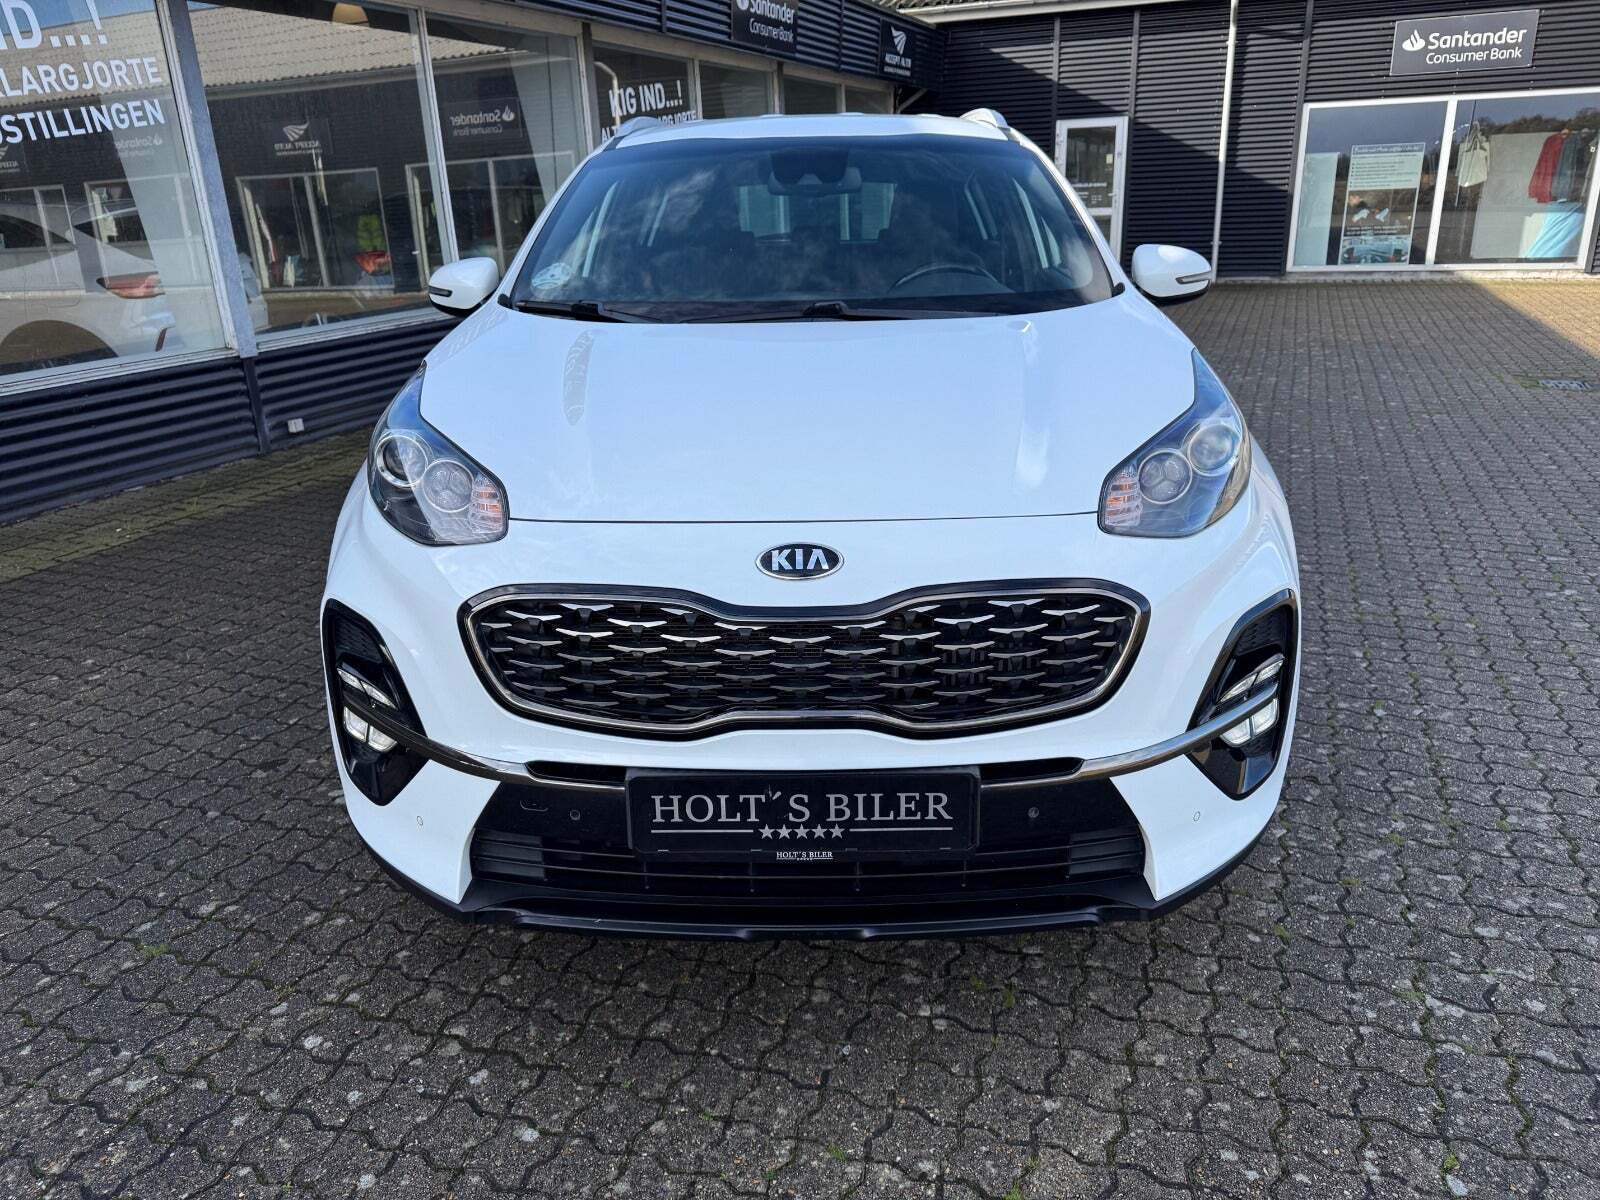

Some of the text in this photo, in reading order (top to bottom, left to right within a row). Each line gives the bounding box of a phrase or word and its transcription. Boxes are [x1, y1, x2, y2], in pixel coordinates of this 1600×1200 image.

[0, 0, 108, 50] D...!
[1427, 27, 1527, 50] Santander
[1426, 47, 1523, 65] Consumer Bank
[0, 56, 162, 98] LARGJORTE
[609, 86, 637, 118] KIG
[0, 98, 165, 145] STILLINGEN
[771, 548, 829, 571] KIA
[825, 792, 953, 822] BILER
